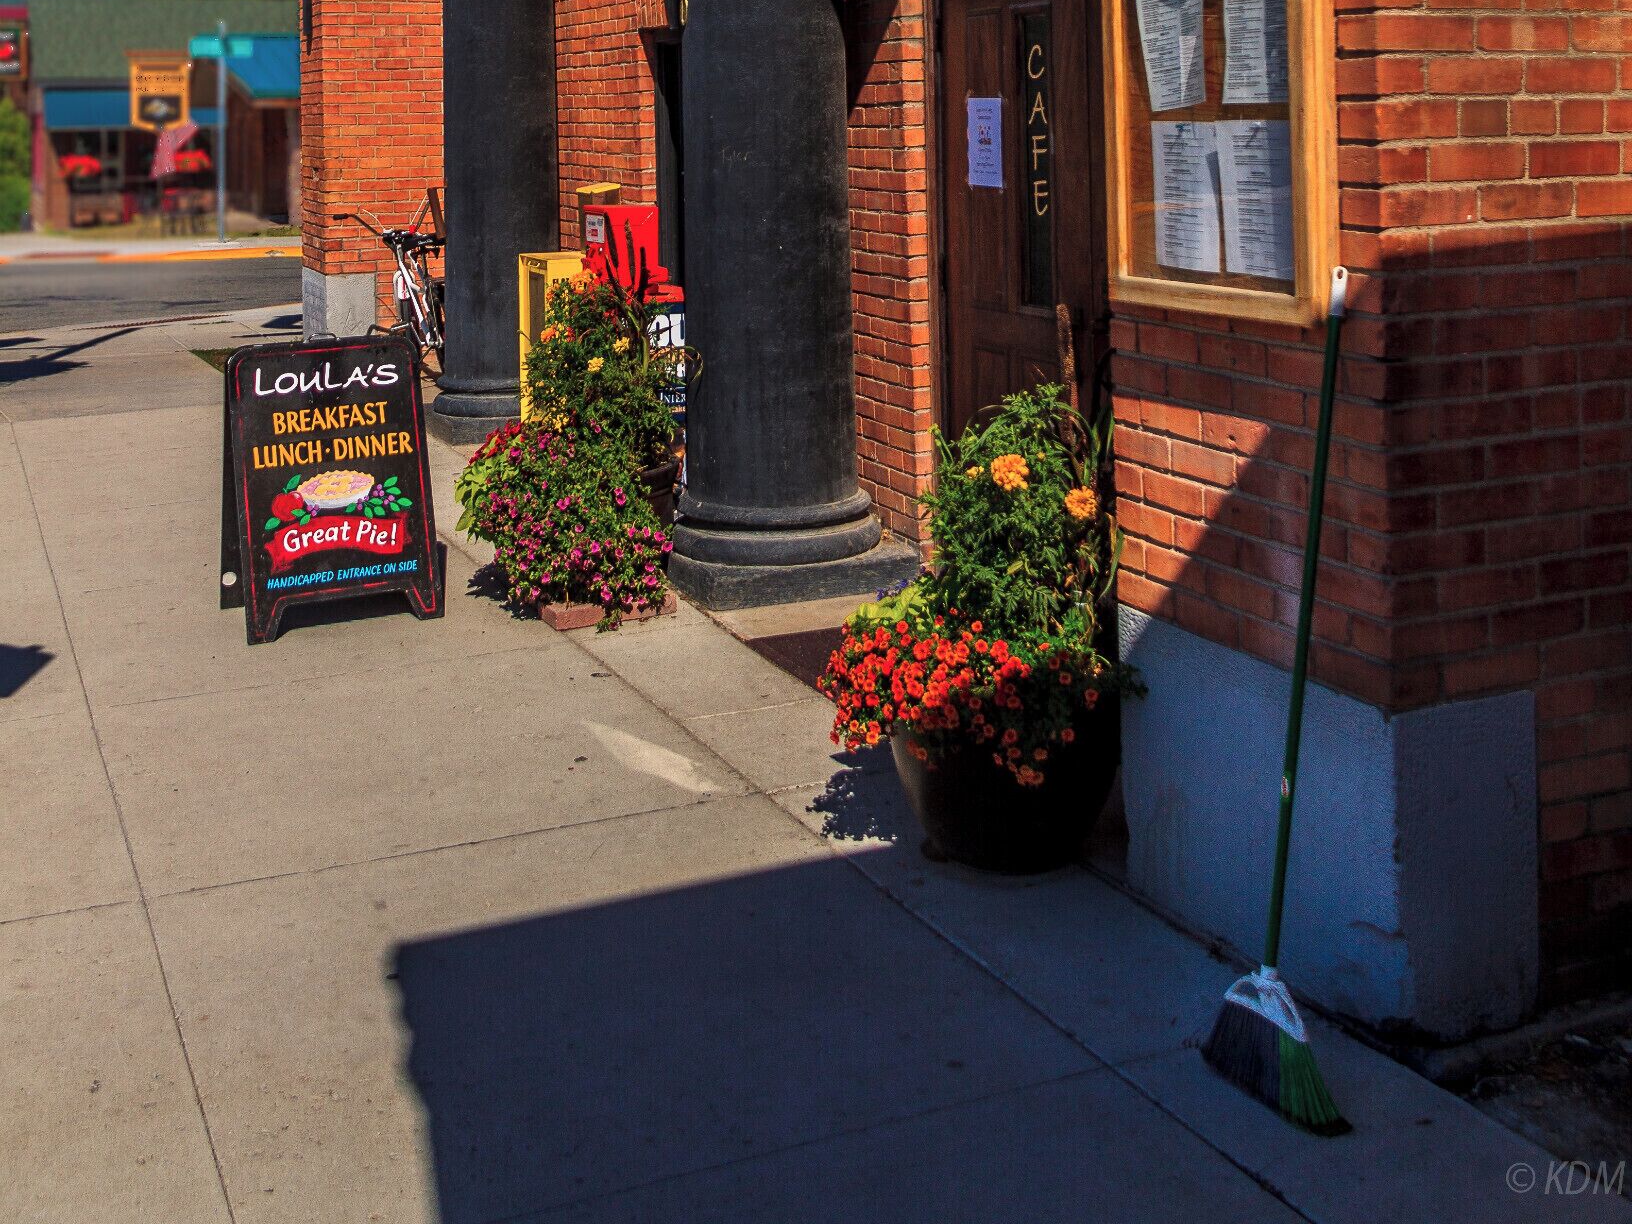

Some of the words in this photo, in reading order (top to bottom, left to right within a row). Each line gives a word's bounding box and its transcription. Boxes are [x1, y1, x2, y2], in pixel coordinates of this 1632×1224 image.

[1028, 44, 1048, 216] CAFE
[272, 400, 388, 436] BREAKFAST
[252, 440, 322, 470] LUNCH
[334, 431, 413, 461] DINNER
[282, 519, 351, 553] Great
[356, 519, 397, 546] Pie!
[267, 570, 334, 590] HANDICAPPED
[337, 564, 382, 580] ENTRANCE
[383, 562, 397, 574] ON
[398, 558, 418, 573] SIDE
